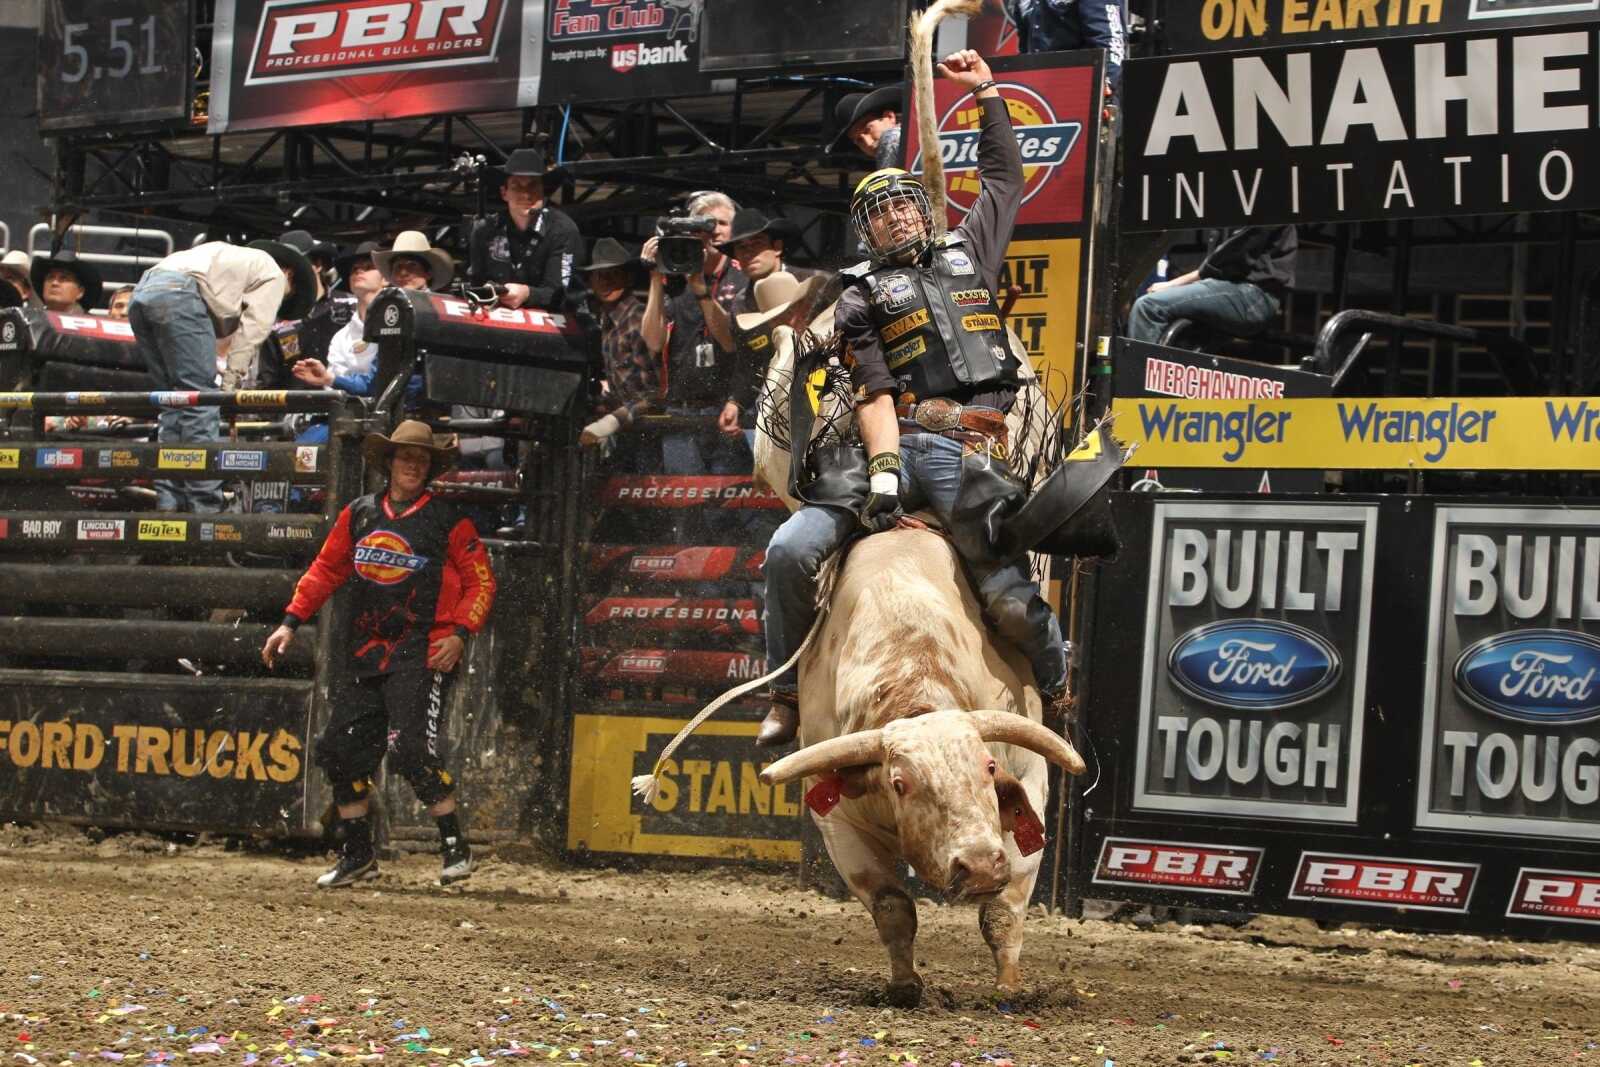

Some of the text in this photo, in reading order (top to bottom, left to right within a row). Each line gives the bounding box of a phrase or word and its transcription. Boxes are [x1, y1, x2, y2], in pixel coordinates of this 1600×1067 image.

[268, 0, 487, 55] PBR
[553, 3, 664, 36] Fan Club
[1201, 0, 1269, 40] ON
[61, 15, 164, 83] 5.51
[266, 37, 484, 68] PROFESSIONAL BULL RIDERS
[1141, 149, 1574, 221] INVITATIO
[964, 316, 998, 328] STANLEY
[1145, 357, 1285, 401] MERCHANDISE
[1138, 404, 1292, 462] Wrangler
[1338, 403, 1496, 463] Wrangler
[1545, 400, 1600, 443] Wr
[162, 451, 203, 467] Wrangler
[254, 481, 284, 500] BUILT
[22, 520, 62, 535] BAD BOY
[355, 545, 419, 571] Dickies
[632, 559, 675, 568] PBR
[1168, 528, 1359, 612] BUILT
[623, 659, 664, 668] PBR
[1208, 638, 1297, 688] Ford
[1500, 650, 1595, 700] Ford
[113, 725, 301, 782] TRUCKS
[1157, 716, 1341, 788] TOUGH
[1107, 847, 1249, 879] PBR
[1305, 862, 1463, 895] PBR
[1303, 885, 1382, 897] PROFESSIONAL
